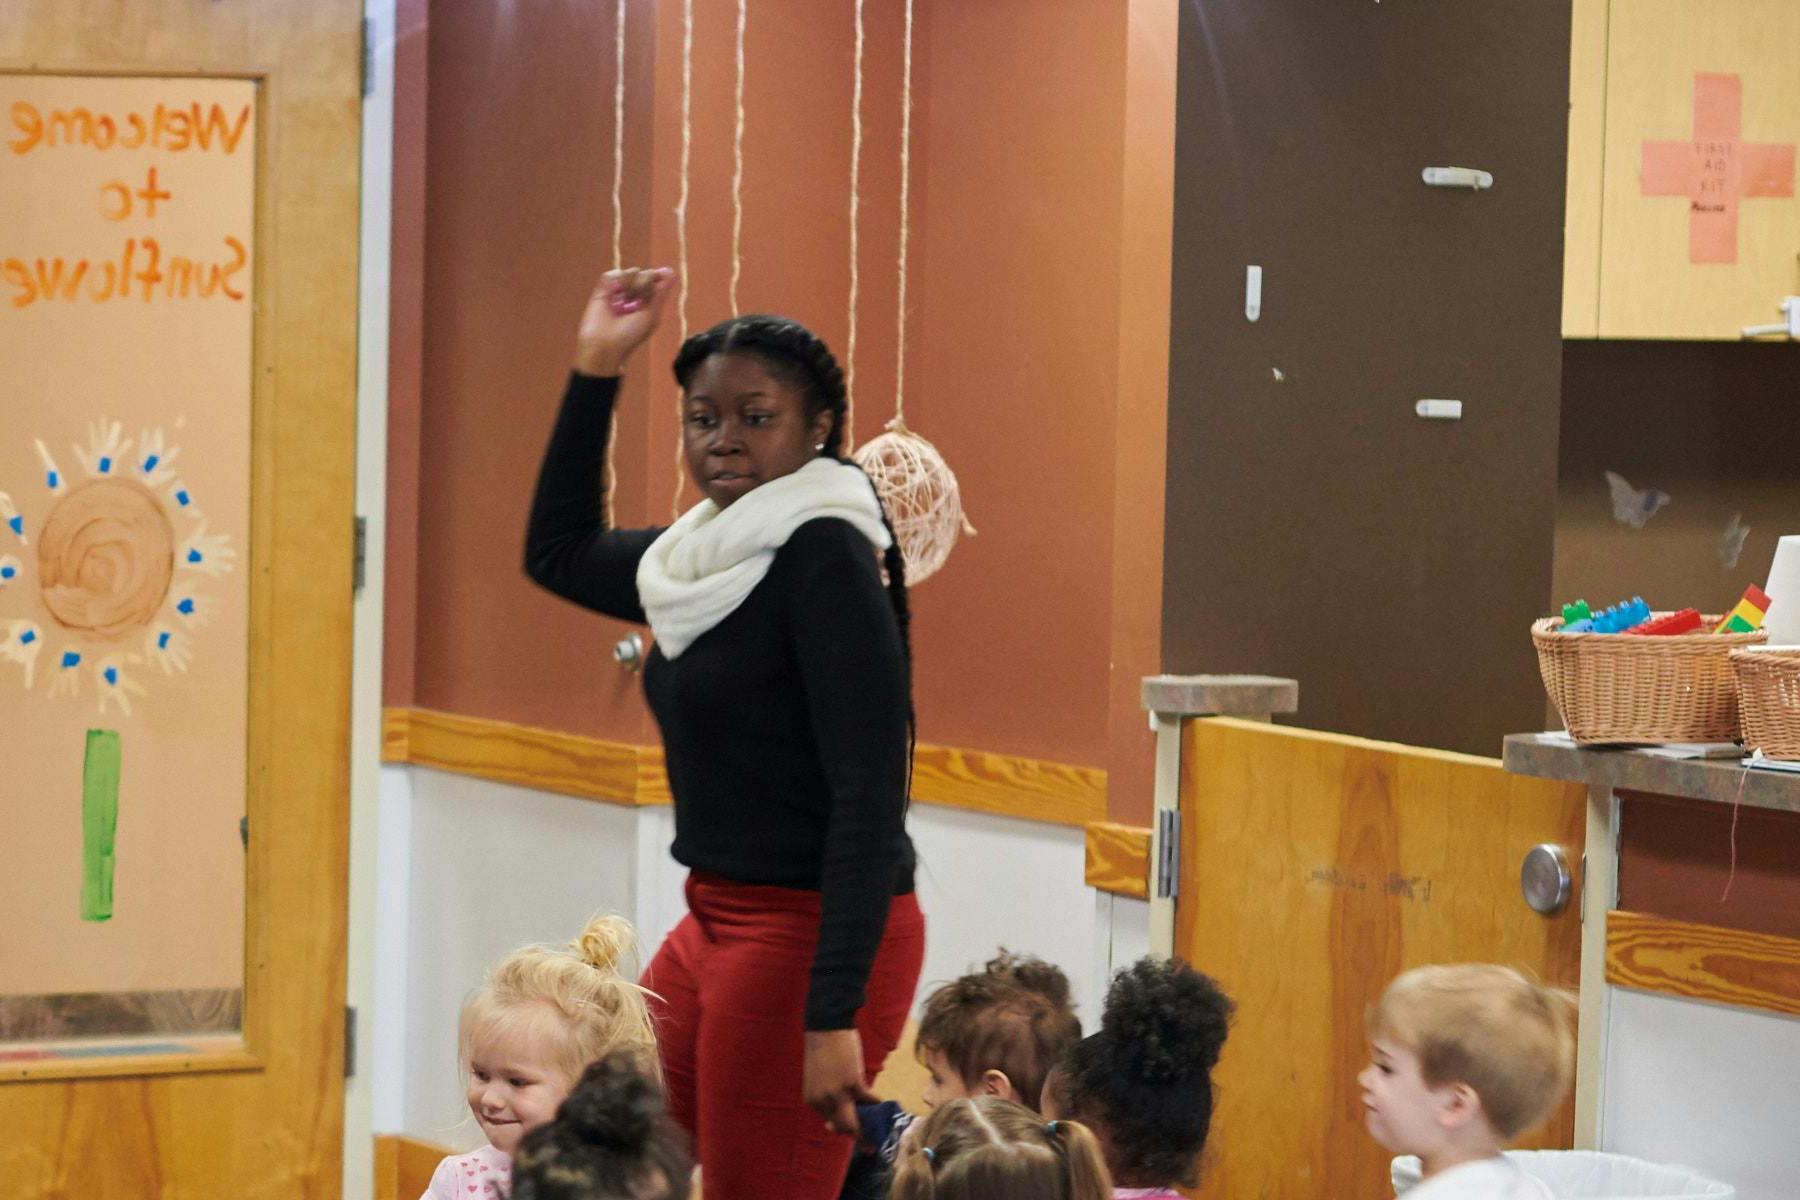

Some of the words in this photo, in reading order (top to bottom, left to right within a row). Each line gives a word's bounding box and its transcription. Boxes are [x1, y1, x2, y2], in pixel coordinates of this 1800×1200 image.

[1695, 142, 1733, 155] FIRST
[1704, 158, 1727, 171] AID
[1700, 178, 1727, 192] KIT
